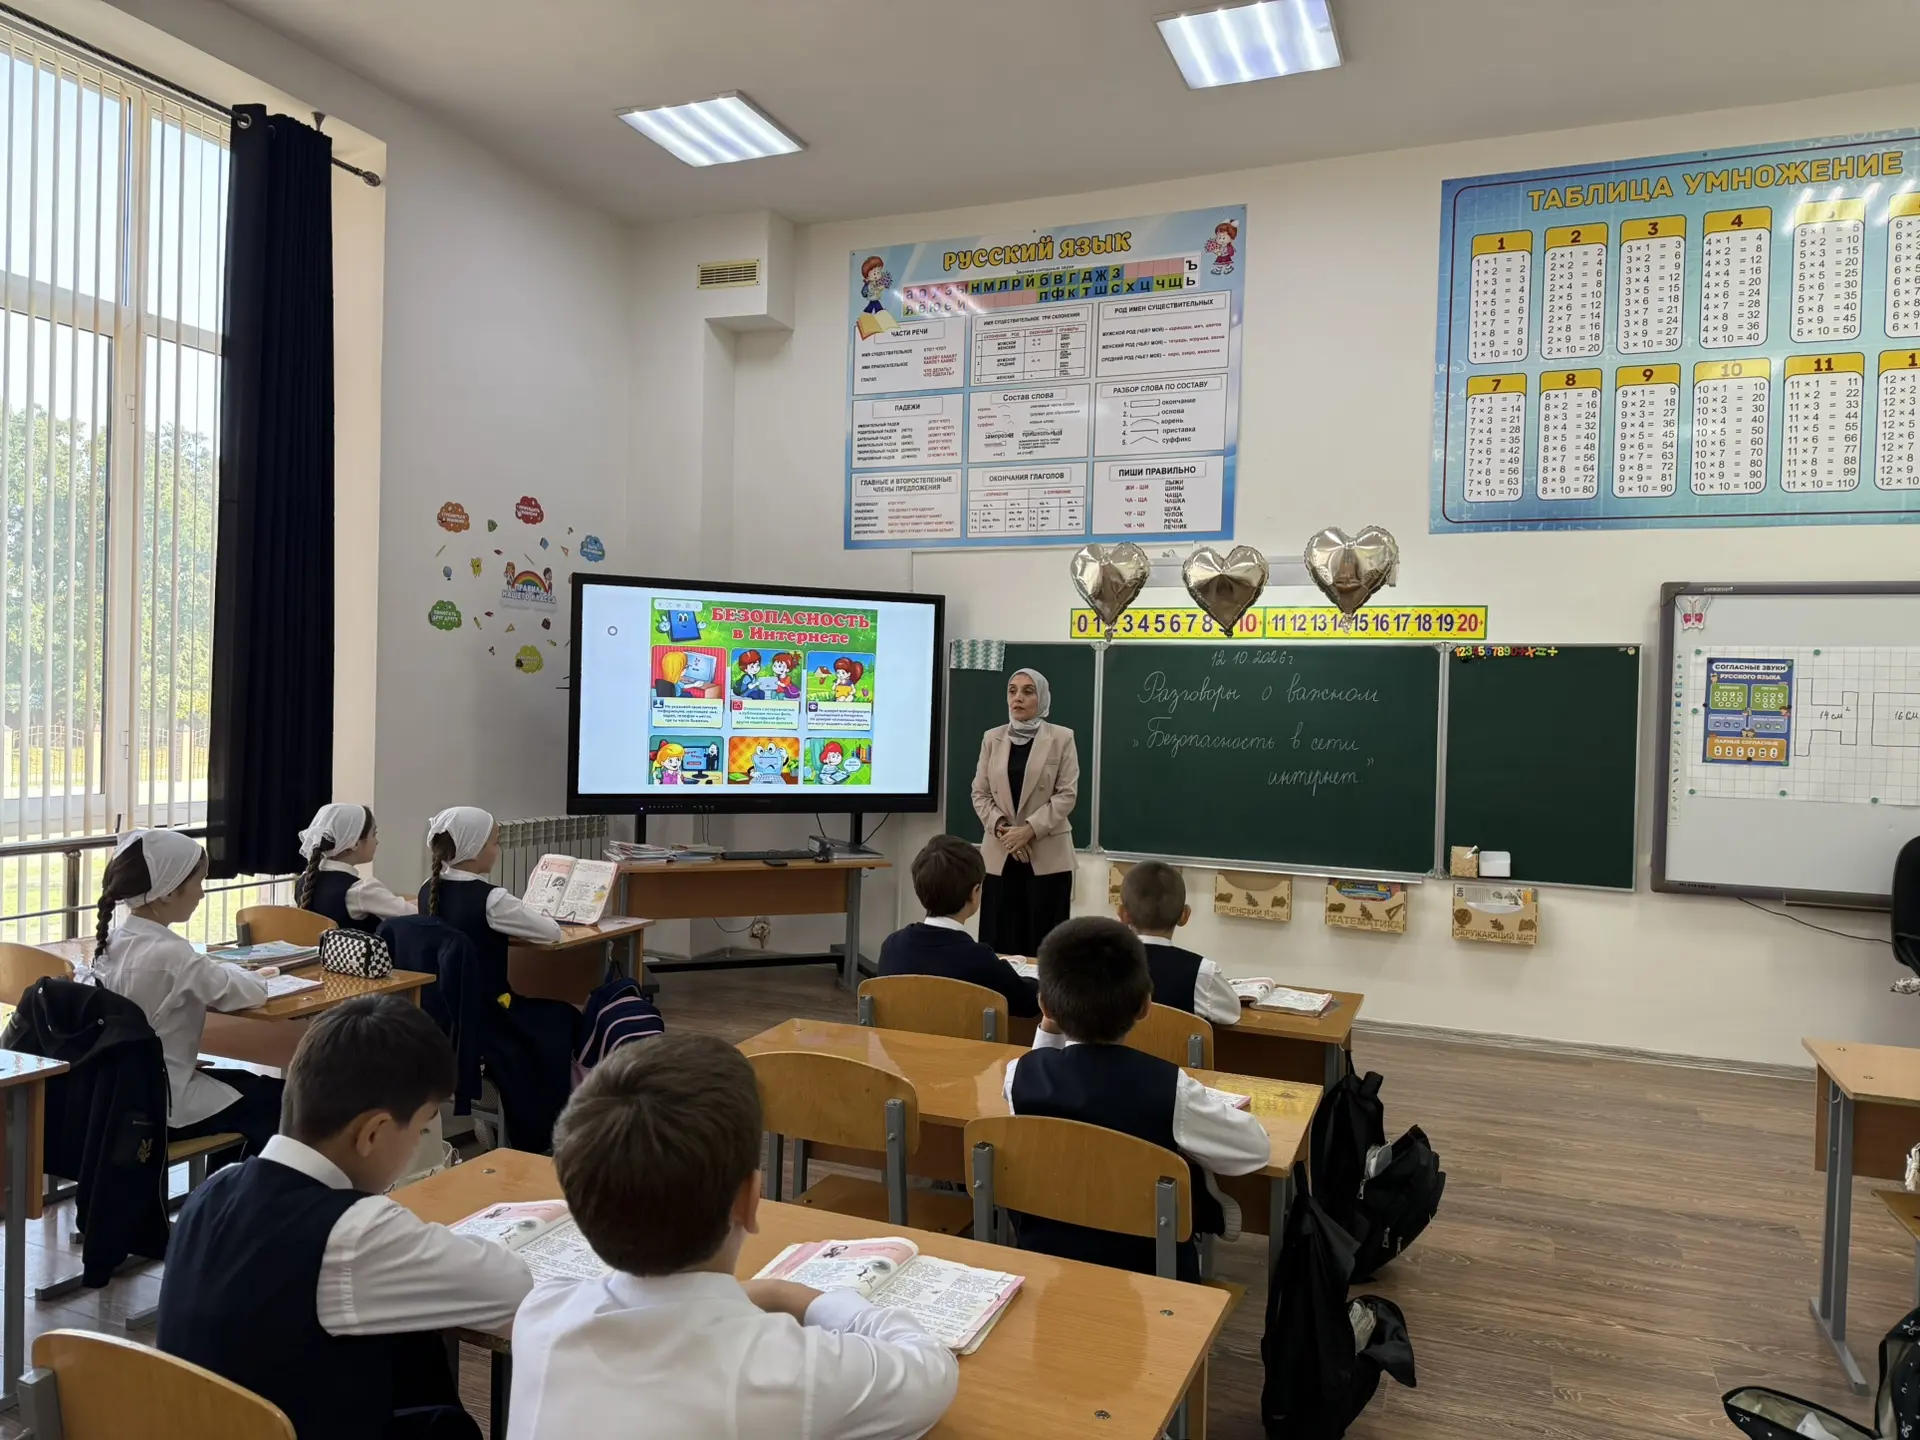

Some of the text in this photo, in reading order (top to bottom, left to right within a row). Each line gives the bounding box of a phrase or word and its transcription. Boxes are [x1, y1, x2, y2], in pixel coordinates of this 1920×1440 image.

[1528, 151, 1904, 211] ТАБЛИЦА УМНОЖЕНИЕ
[1731, 214, 1743, 228] 4
[1648, 222, 1659, 236] 3
[1571, 230, 1581, 243] 2
[943, 231, 1132, 271] РУССКИЙ ЯЗЫК
[1497, 238, 1505, 250] 1
[1148, 299, 1213, 311] СУЩЕСТВИТЕЛЬНЫХ
[891, 329, 910, 337] ЧАСТИ
[1721, 363, 1742, 377] 10
[1814, 358, 1834, 372] 11
[1565, 373, 1576, 386] 8
[1642, 369, 1653, 381] 9
[1113, 386, 1139, 394] РАЗБОР
[1141, 384, 1164, 392] СЛОВА
[1177, 381, 1208, 389] СОСТАВУ
[1492, 379, 1501, 392] 7
[989, 472, 1064, 482] ОКОНЧАНИЯ ГЛАГОЛОВ
[1119, 466, 1196, 477] ПИШИ ПРАВИЛЬНО
[896, 476, 952, 484] ВТОРОСТЕПЕННЫЕ
[711, 607, 870, 629] БЕЗОПАСНОСТЬ
[1078, 614, 1087, 632] 0
[1122, 614, 1133, 632] 3
[1138, 614, 1149, 632] 4
[1154, 614, 1165, 632] 5
[1169, 614, 1181, 632] 6
[1186, 614, 1197, 632] 7
[1202, 614, 1212, 632] 8
[1239, 614, 1257, 632] 10
[1272, 614, 1285, 631] 11
[1291, 614, 1306, 631] 12
[1311, 614, 1327, 631] 13
[1353, 614, 1368, 631] 15
[1372, 614, 1389, 631] 16
[1394, 614, 1410, 631] 17
[1415, 614, 1432, 631] 18
[1436, 614, 1454, 631] 19
[1458, 614, 1478, 631] 20
[733, 627, 849, 645] в Интернете
[1138, 670, 1380, 713] Разговоры о важном
[1292, 721, 1303, 749] в
[1311, 738, 1360, 750] сети
[1327, 914, 1401, 929] МАТЕМАТИКА
[1454, 928, 1514, 940] ОКРУЖАЮЩИЙ
